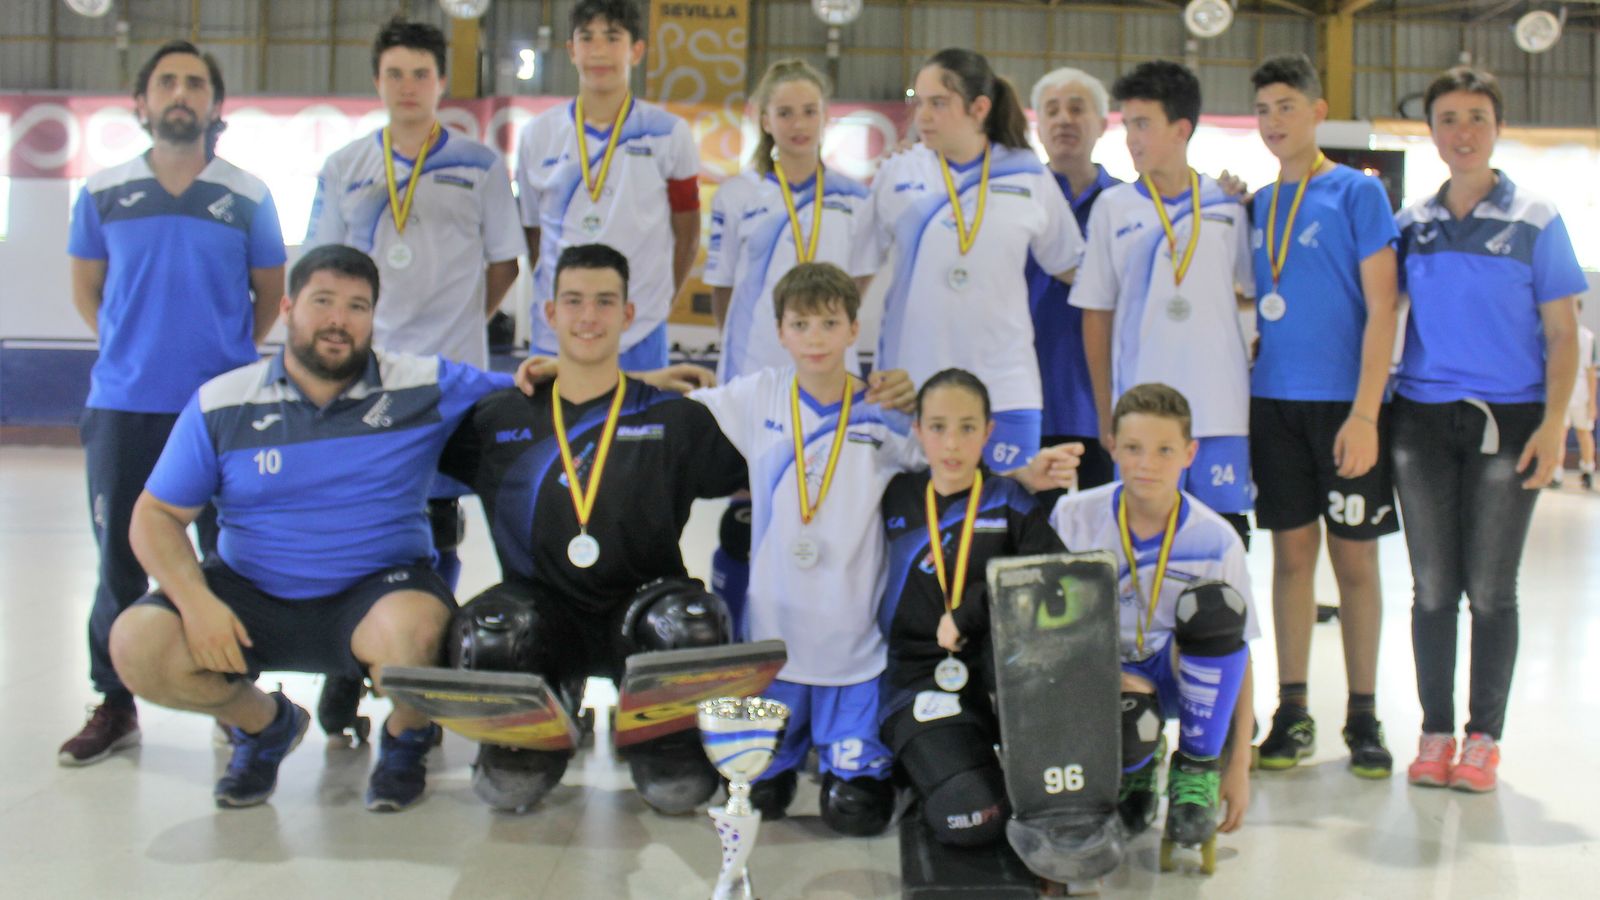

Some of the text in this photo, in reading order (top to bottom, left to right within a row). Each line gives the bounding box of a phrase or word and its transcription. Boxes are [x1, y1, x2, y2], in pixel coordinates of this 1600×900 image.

[660, 2, 738, 19] SEVILLA
[253, 448, 282, 475] 10
[992, 442, 1020, 465] 67
[1210, 464, 1236, 487] 24
[1327, 490, 1365, 526] 20
[831, 740, 862, 772] 12
[1043, 763, 1085, 794] 96
